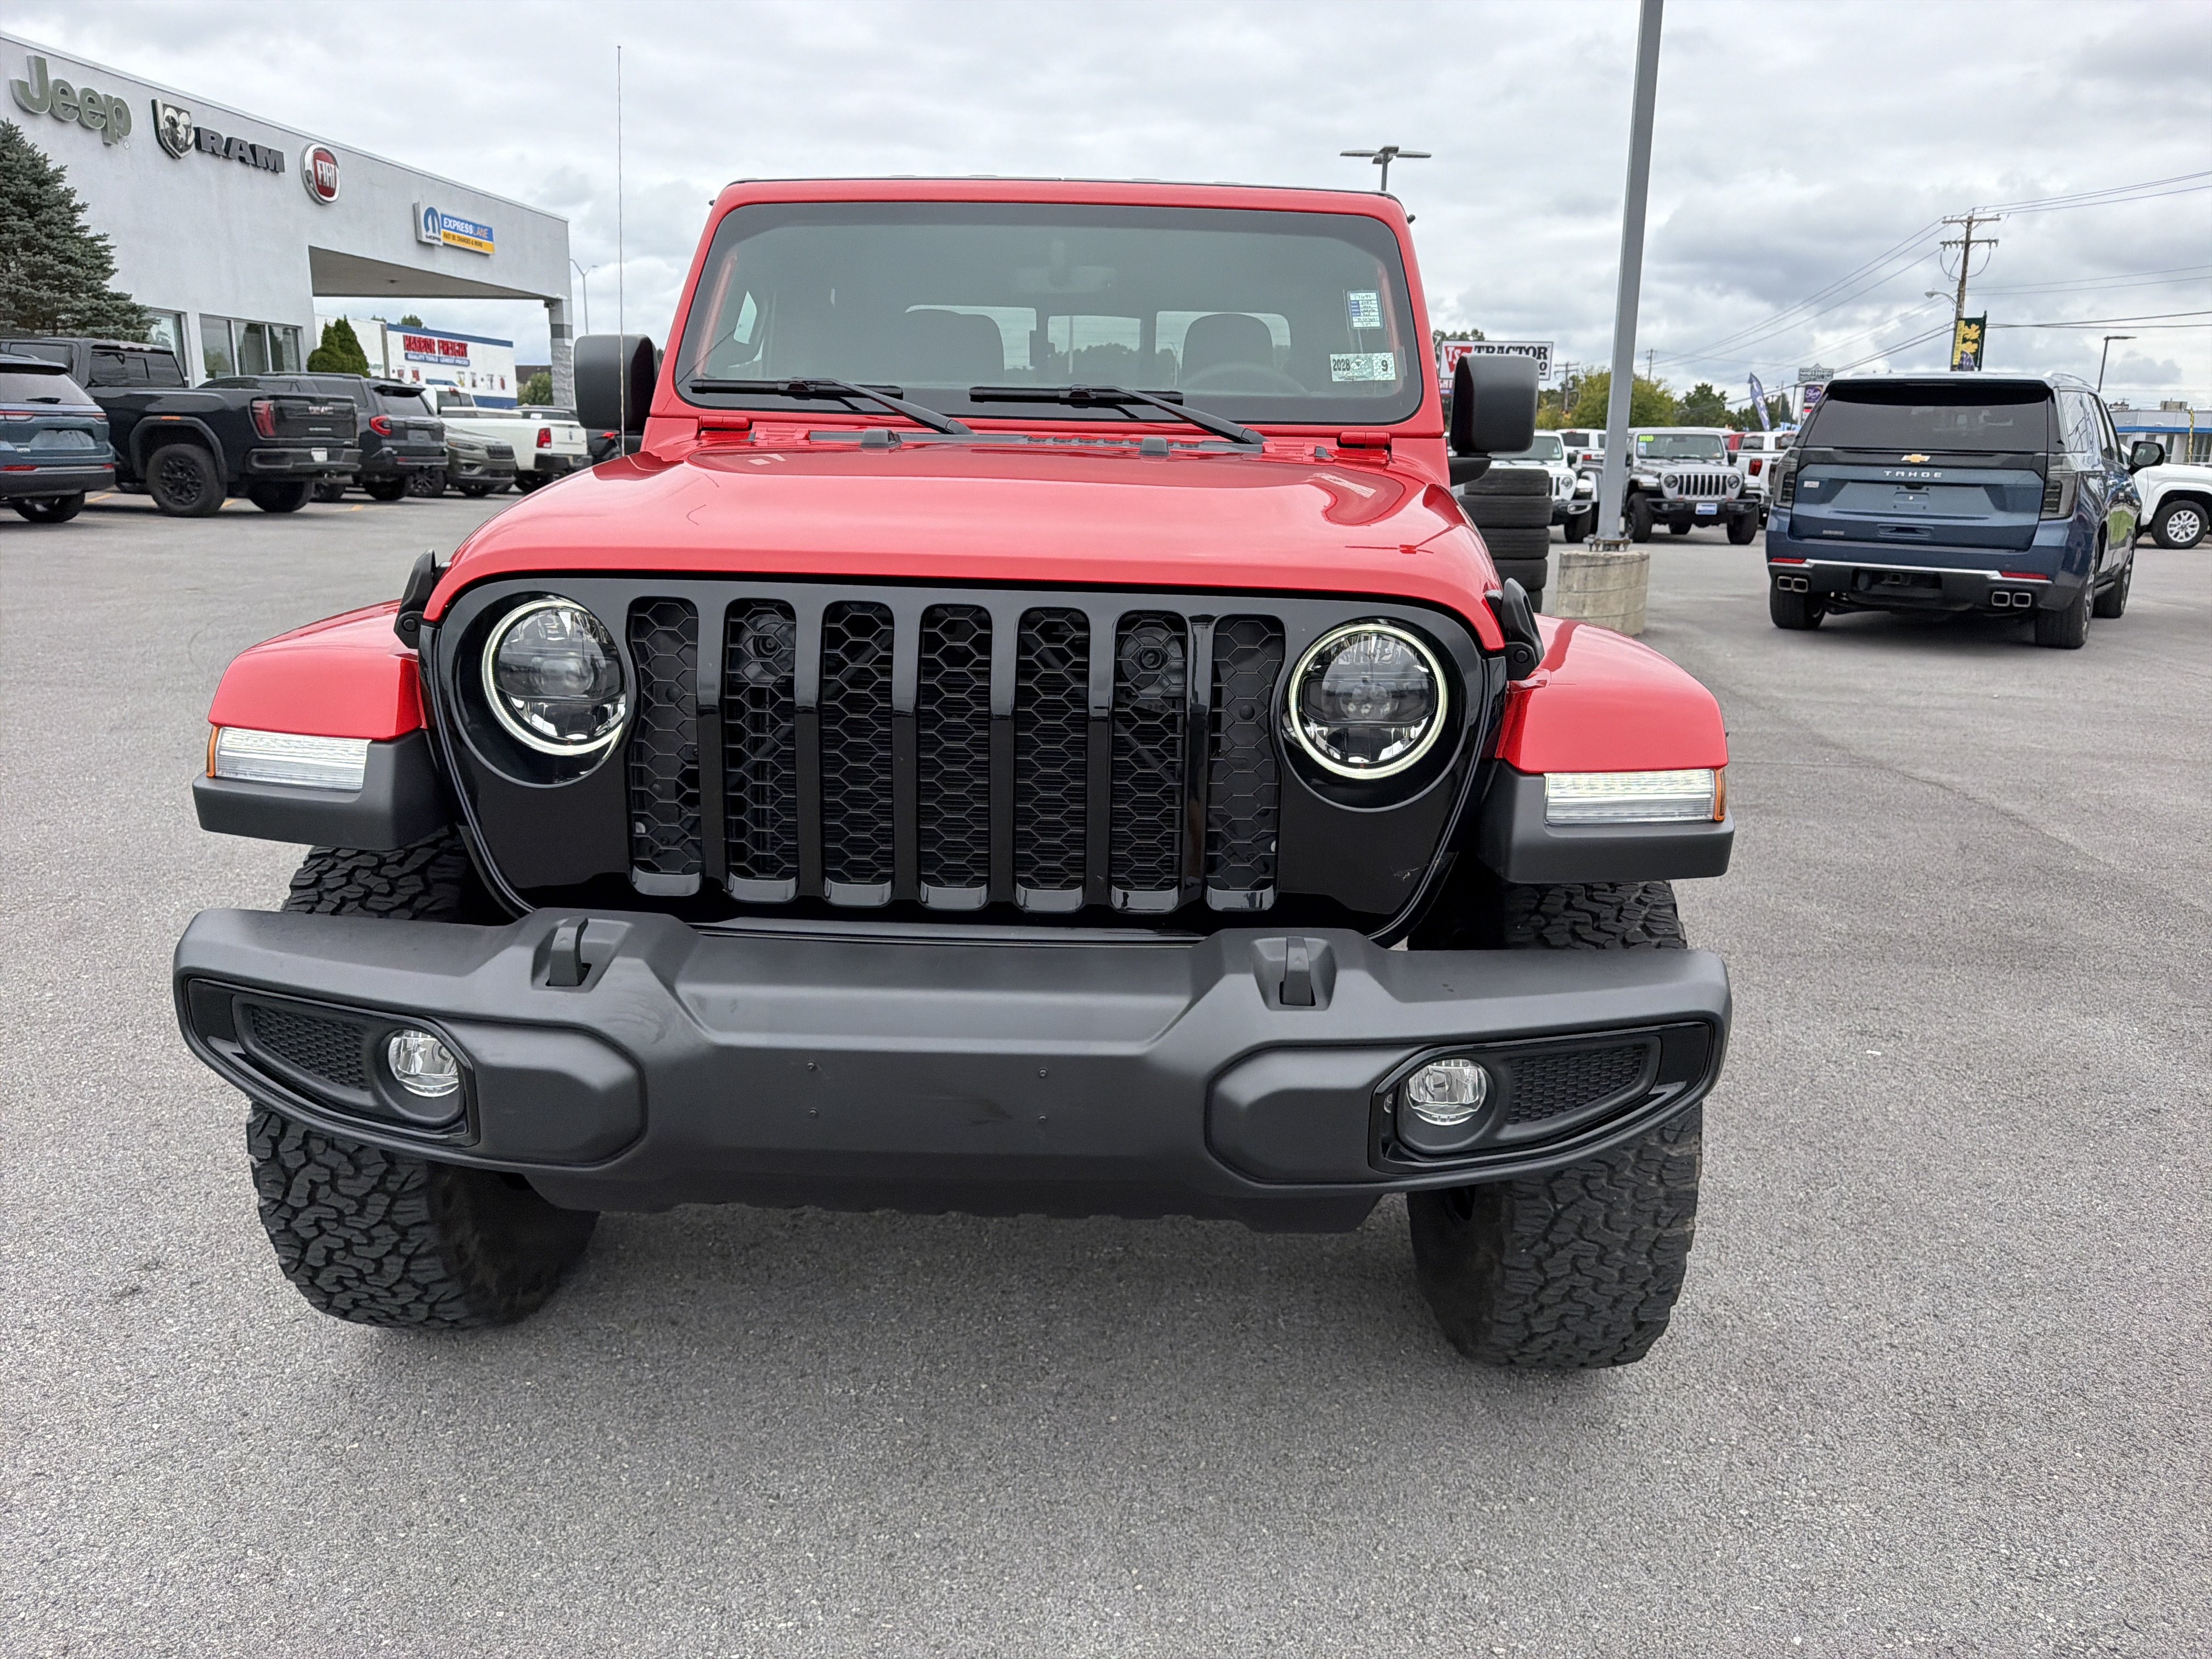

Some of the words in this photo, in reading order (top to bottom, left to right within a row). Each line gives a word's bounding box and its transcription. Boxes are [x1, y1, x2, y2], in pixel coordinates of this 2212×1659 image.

[9, 55, 132, 145] Jeep
[194, 126, 285, 173] RAM
[316, 160, 337, 189] FIAT
[443, 217, 473, 234] EXPRESS
[473, 225, 488, 239] LANE
[403, 335, 436, 354] HARBOR
[437, 339, 468, 357] FREIGHT
[1474, 345, 1548, 360] TRACTOR
[1332, 358, 1350, 371] 2028
[1381, 359, 1388, 372] 9
